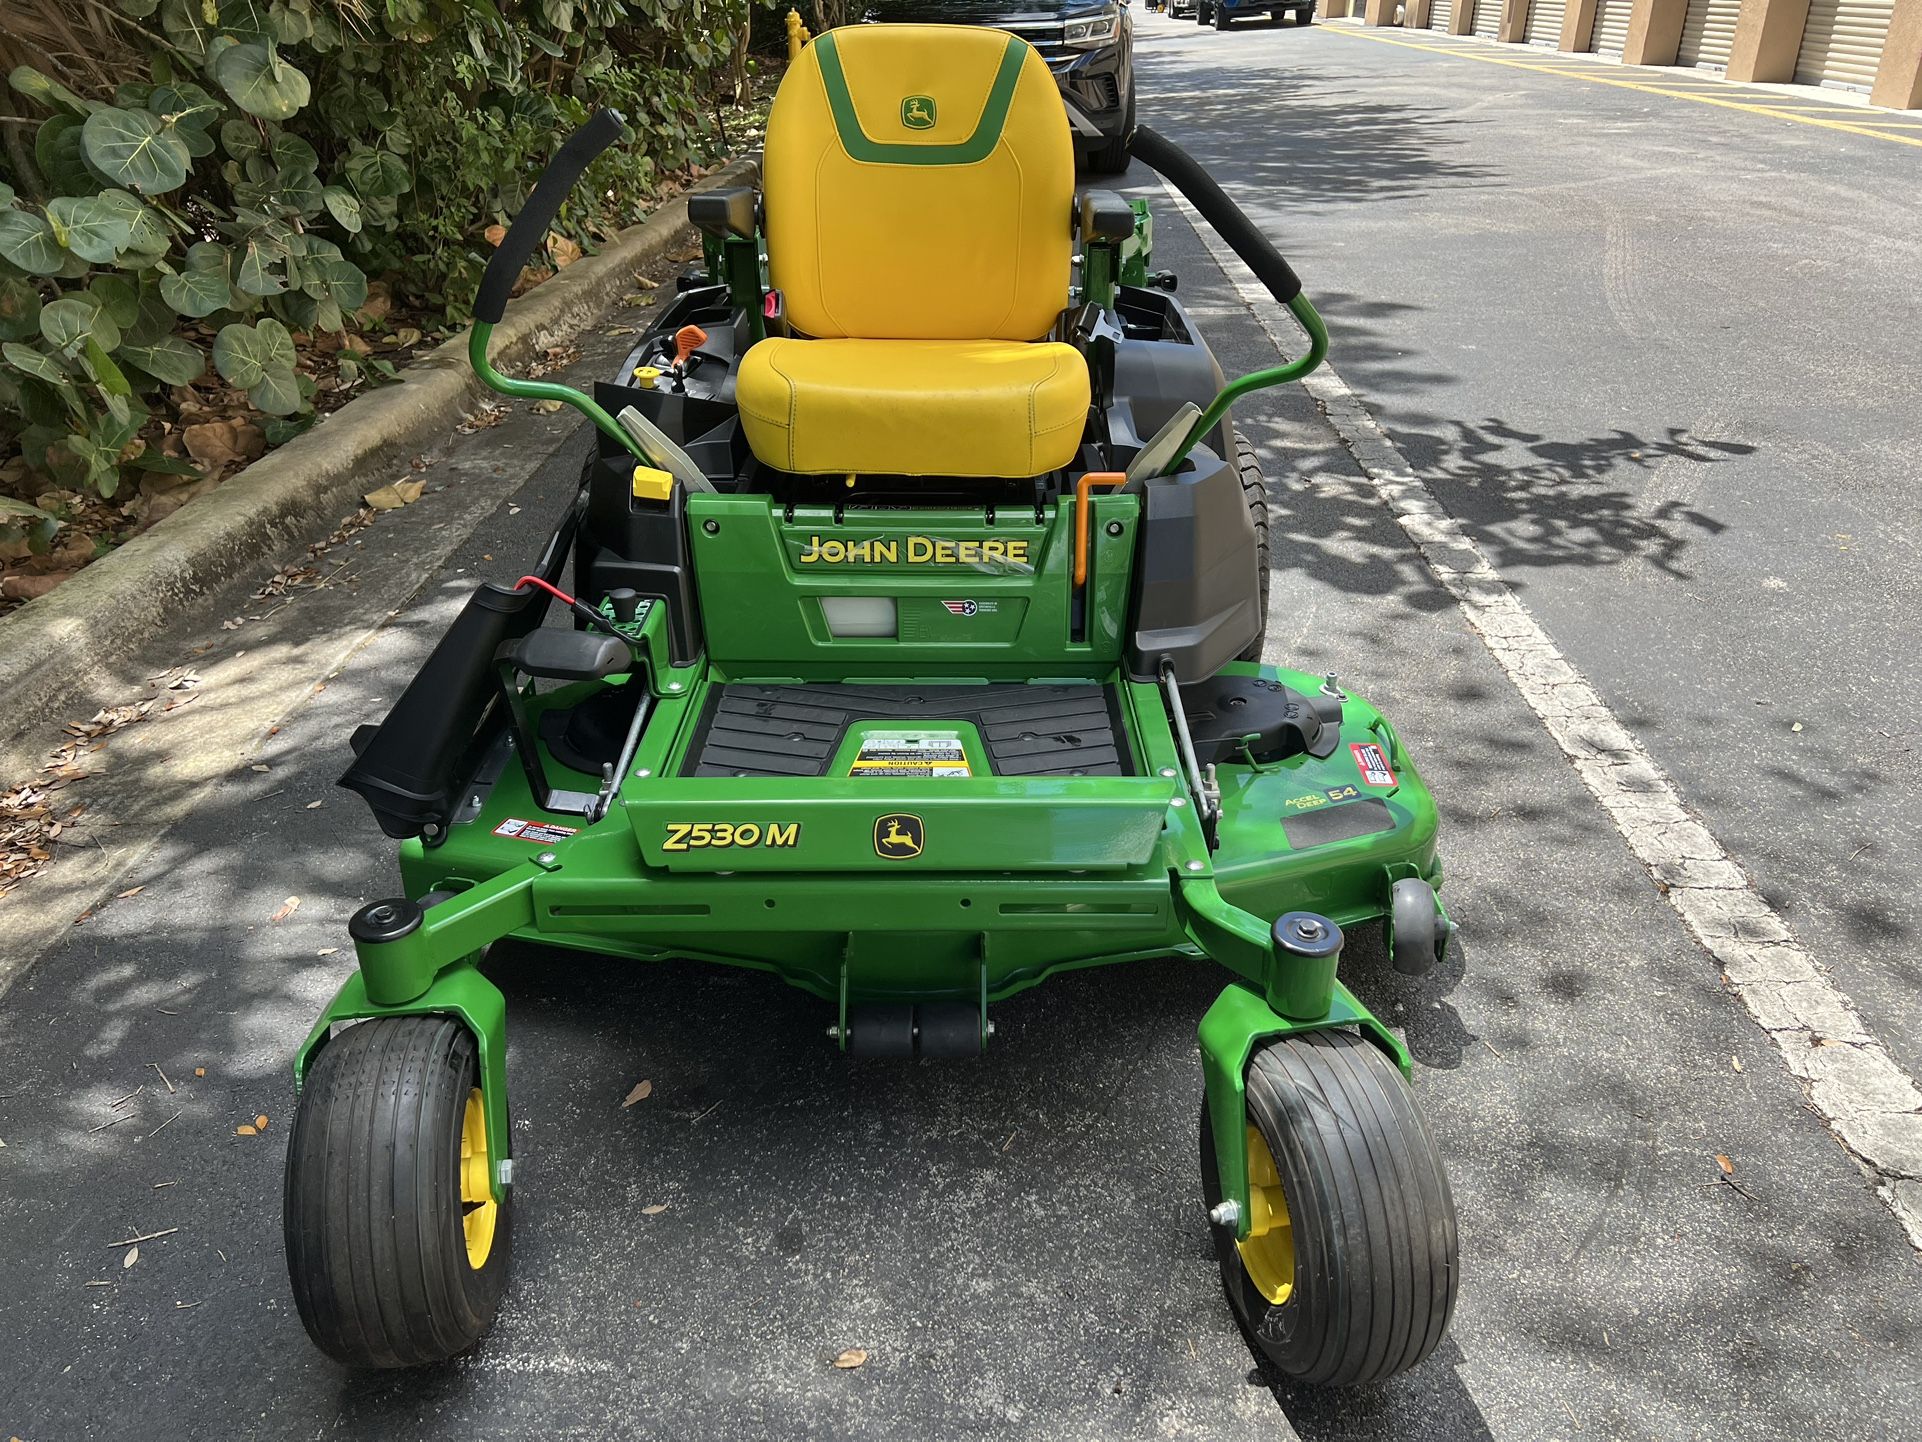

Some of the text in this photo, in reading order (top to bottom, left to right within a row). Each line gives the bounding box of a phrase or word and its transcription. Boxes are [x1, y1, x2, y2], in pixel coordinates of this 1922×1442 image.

[800, 535, 1029, 563] JOHN DEERE
[1328, 786, 1358, 800] 54
[1285, 794, 1320, 806] ACCEL
[1296, 798, 1327, 809] DEEP
